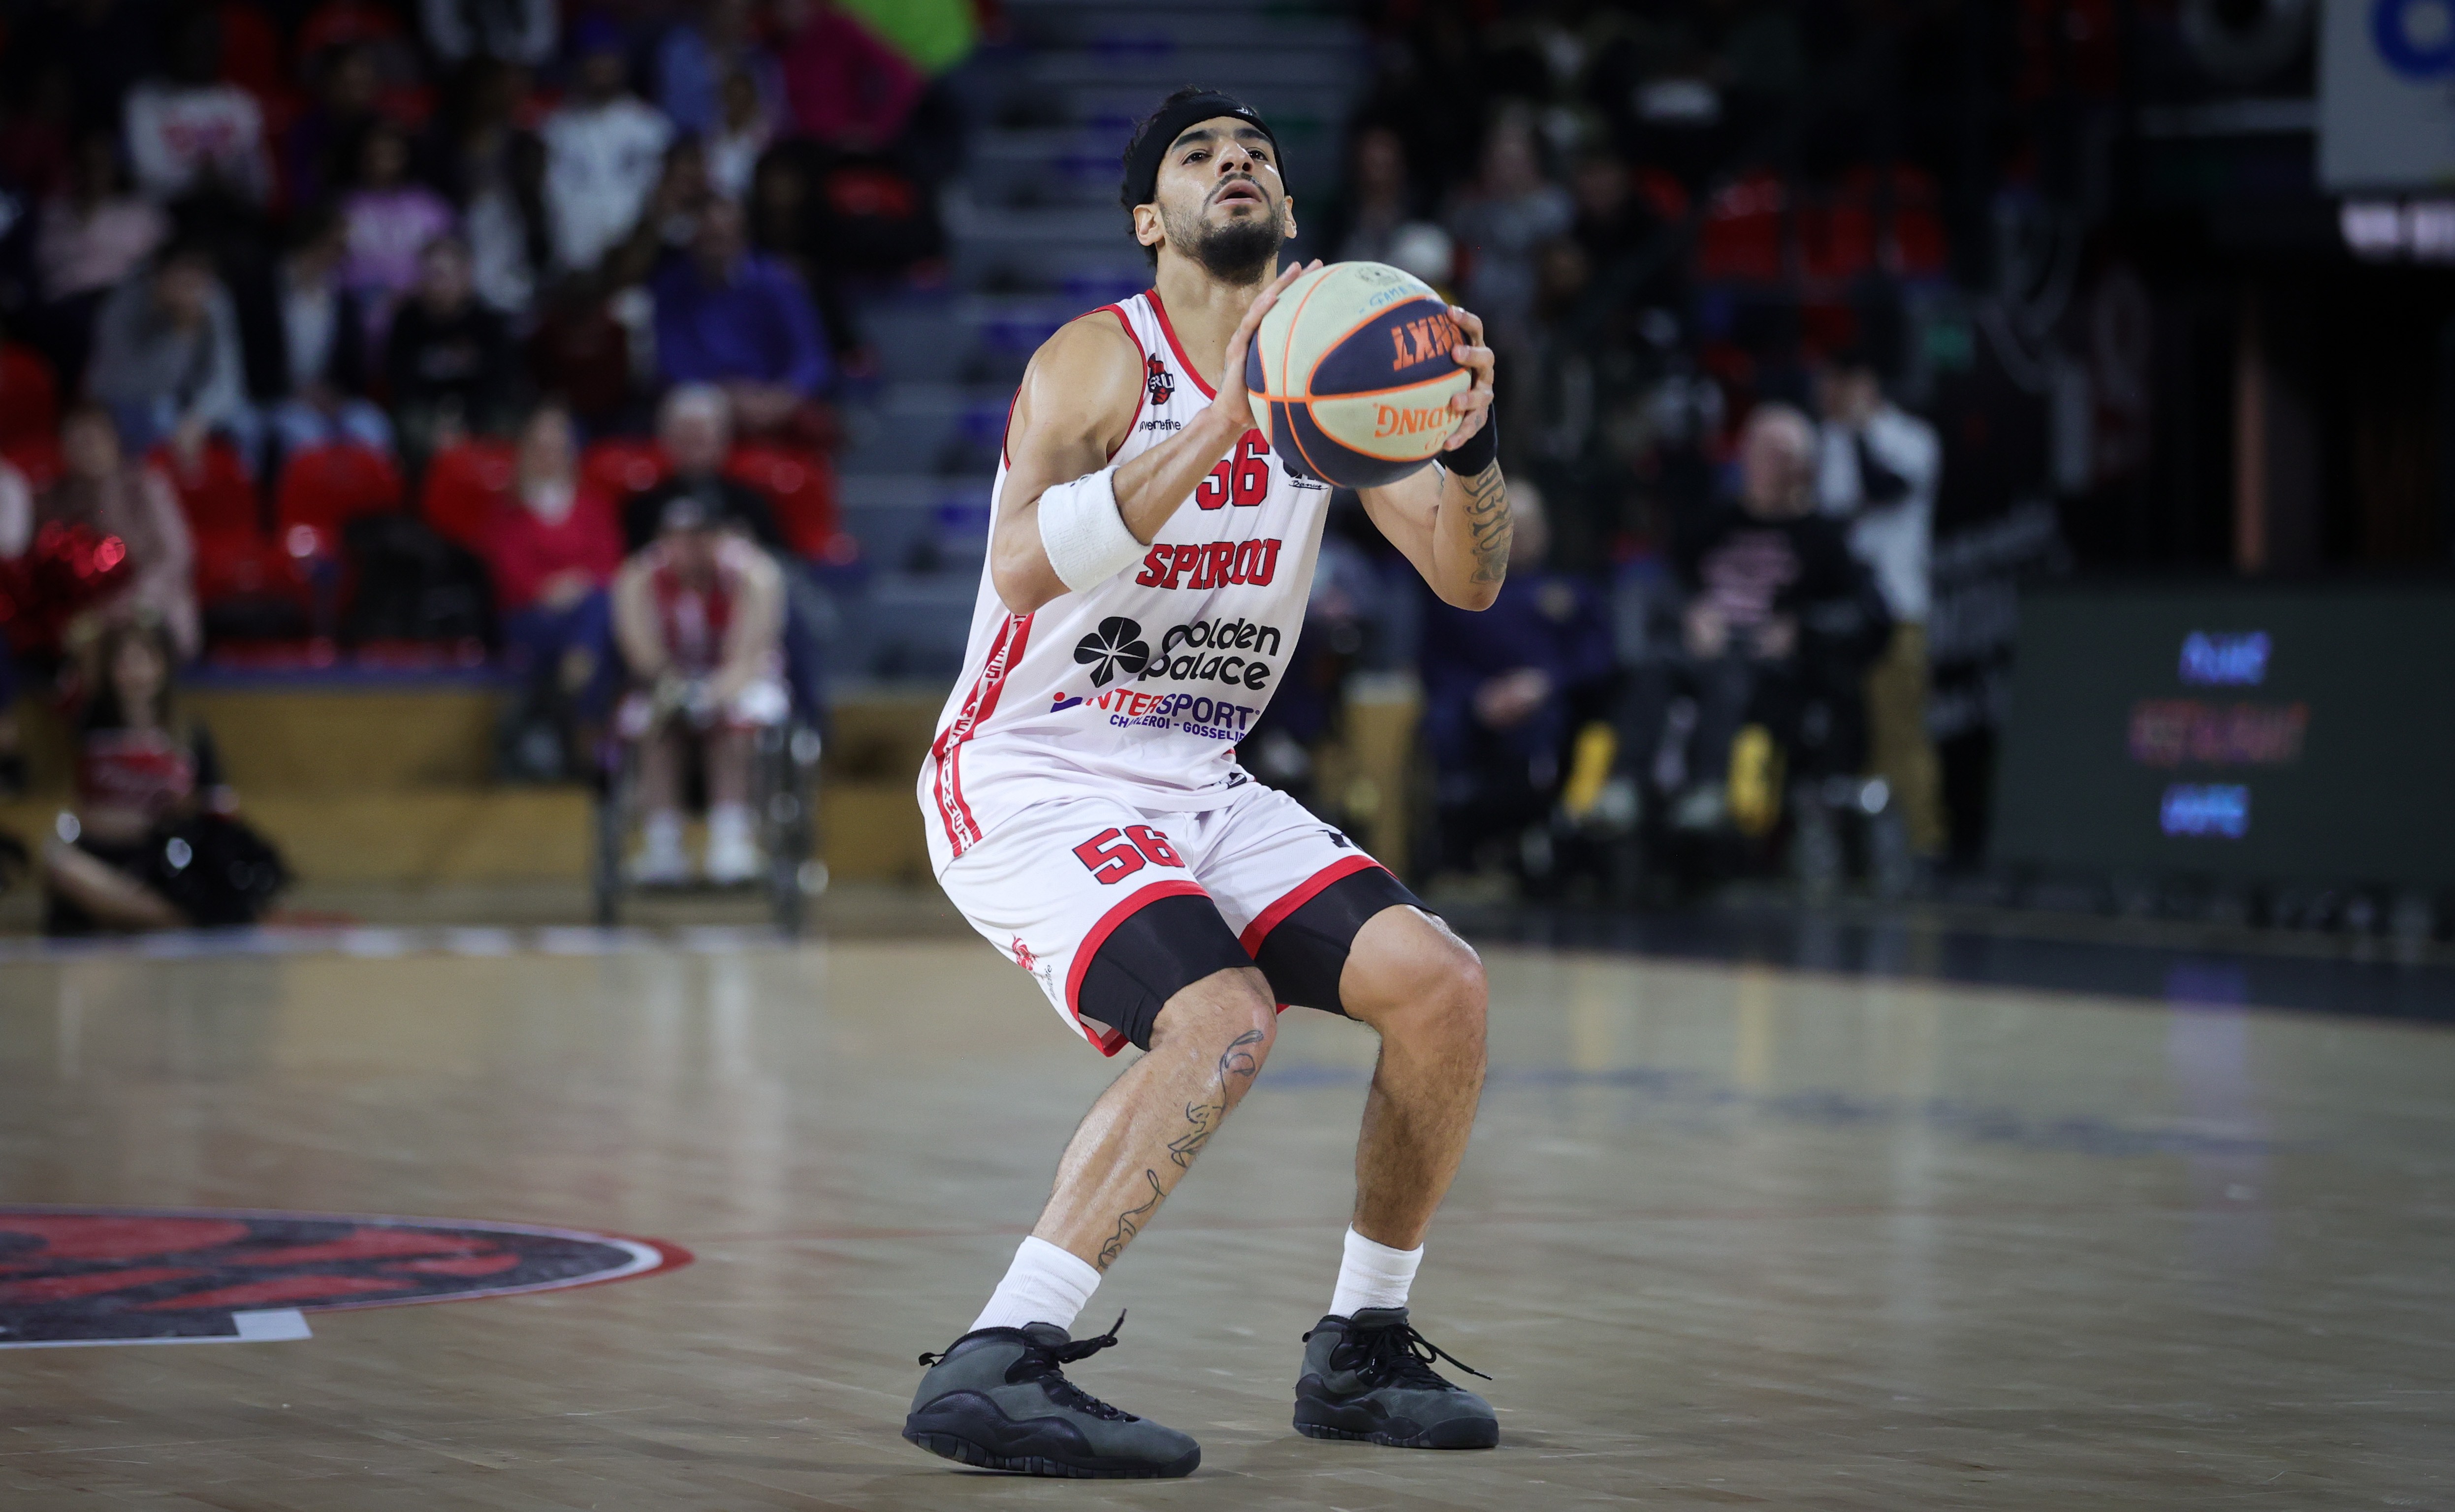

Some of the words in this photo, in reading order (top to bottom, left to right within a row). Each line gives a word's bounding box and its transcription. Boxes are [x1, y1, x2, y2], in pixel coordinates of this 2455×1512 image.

[1195, 428, 1270, 510] 56
[1135, 538, 1282, 590] SPIROU
[1072, 824, 1186, 885] 56
